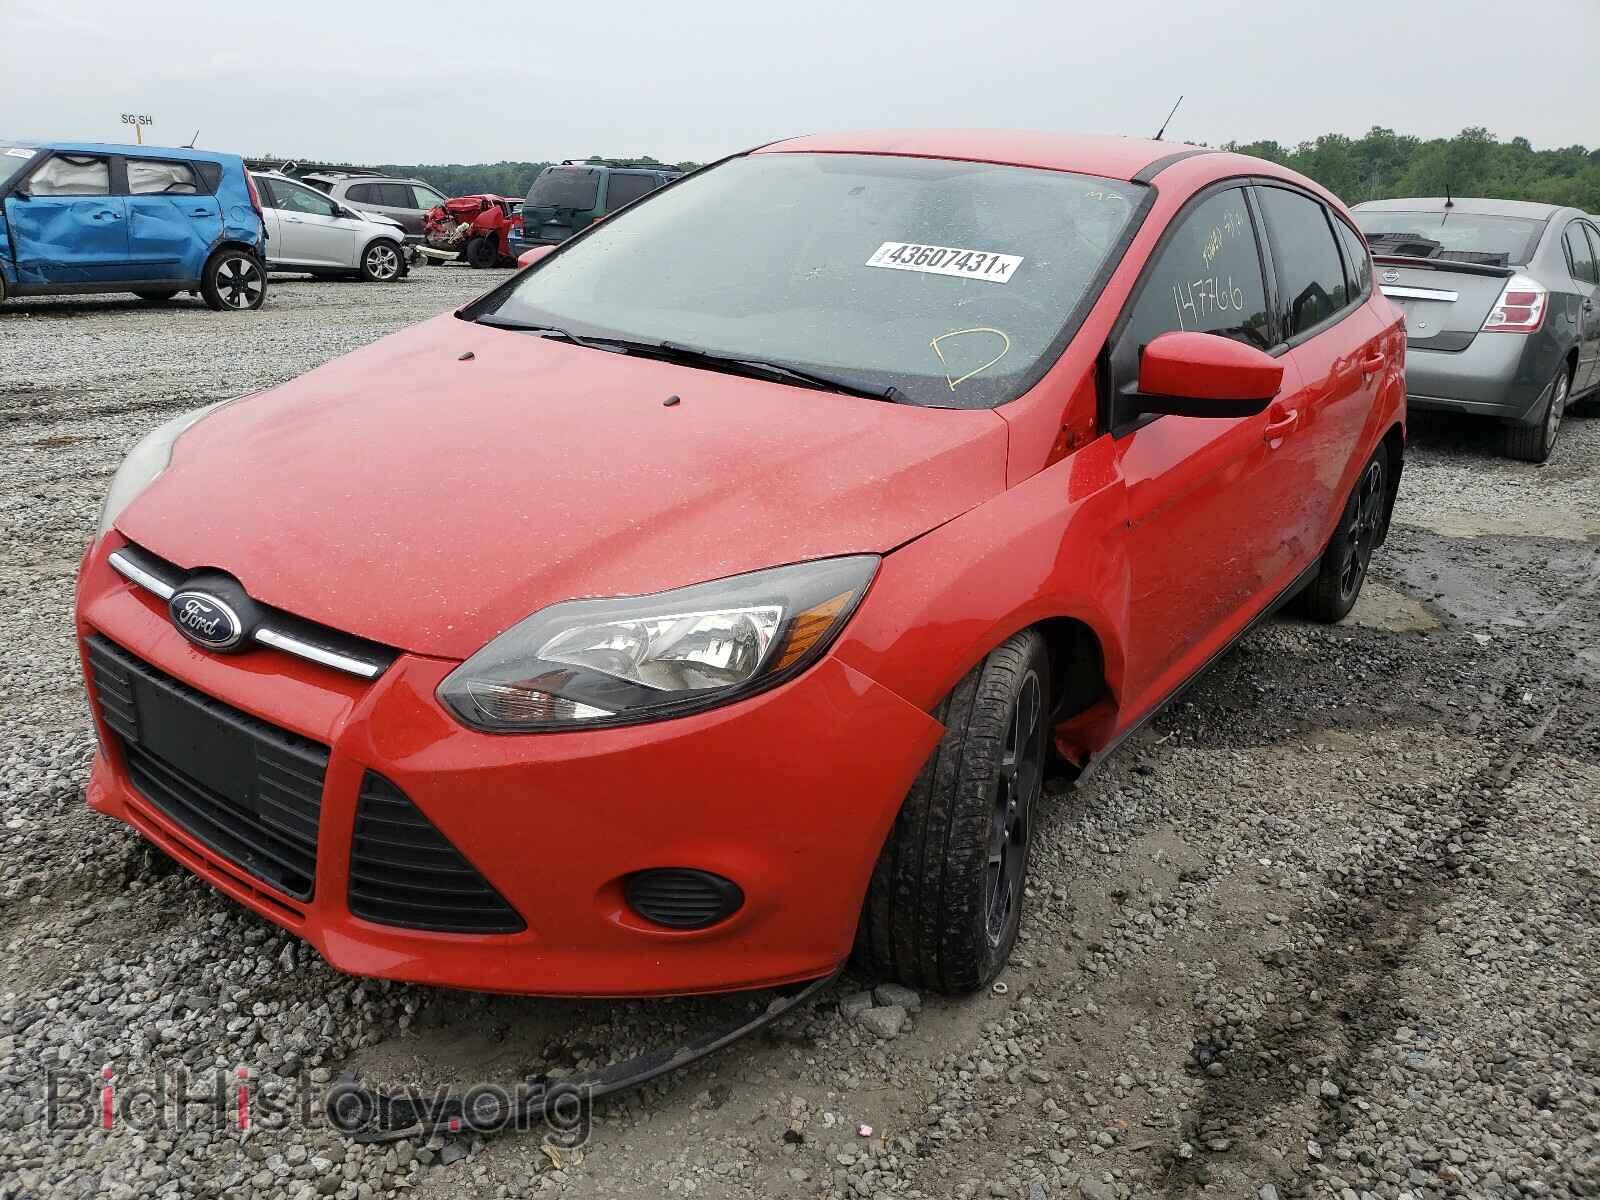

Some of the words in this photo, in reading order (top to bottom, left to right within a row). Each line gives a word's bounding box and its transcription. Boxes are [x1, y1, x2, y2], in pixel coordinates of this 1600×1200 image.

[121, 113, 136, 125] SG
[138, 115, 153, 126] SH
[178, 599, 221, 636] Ford
